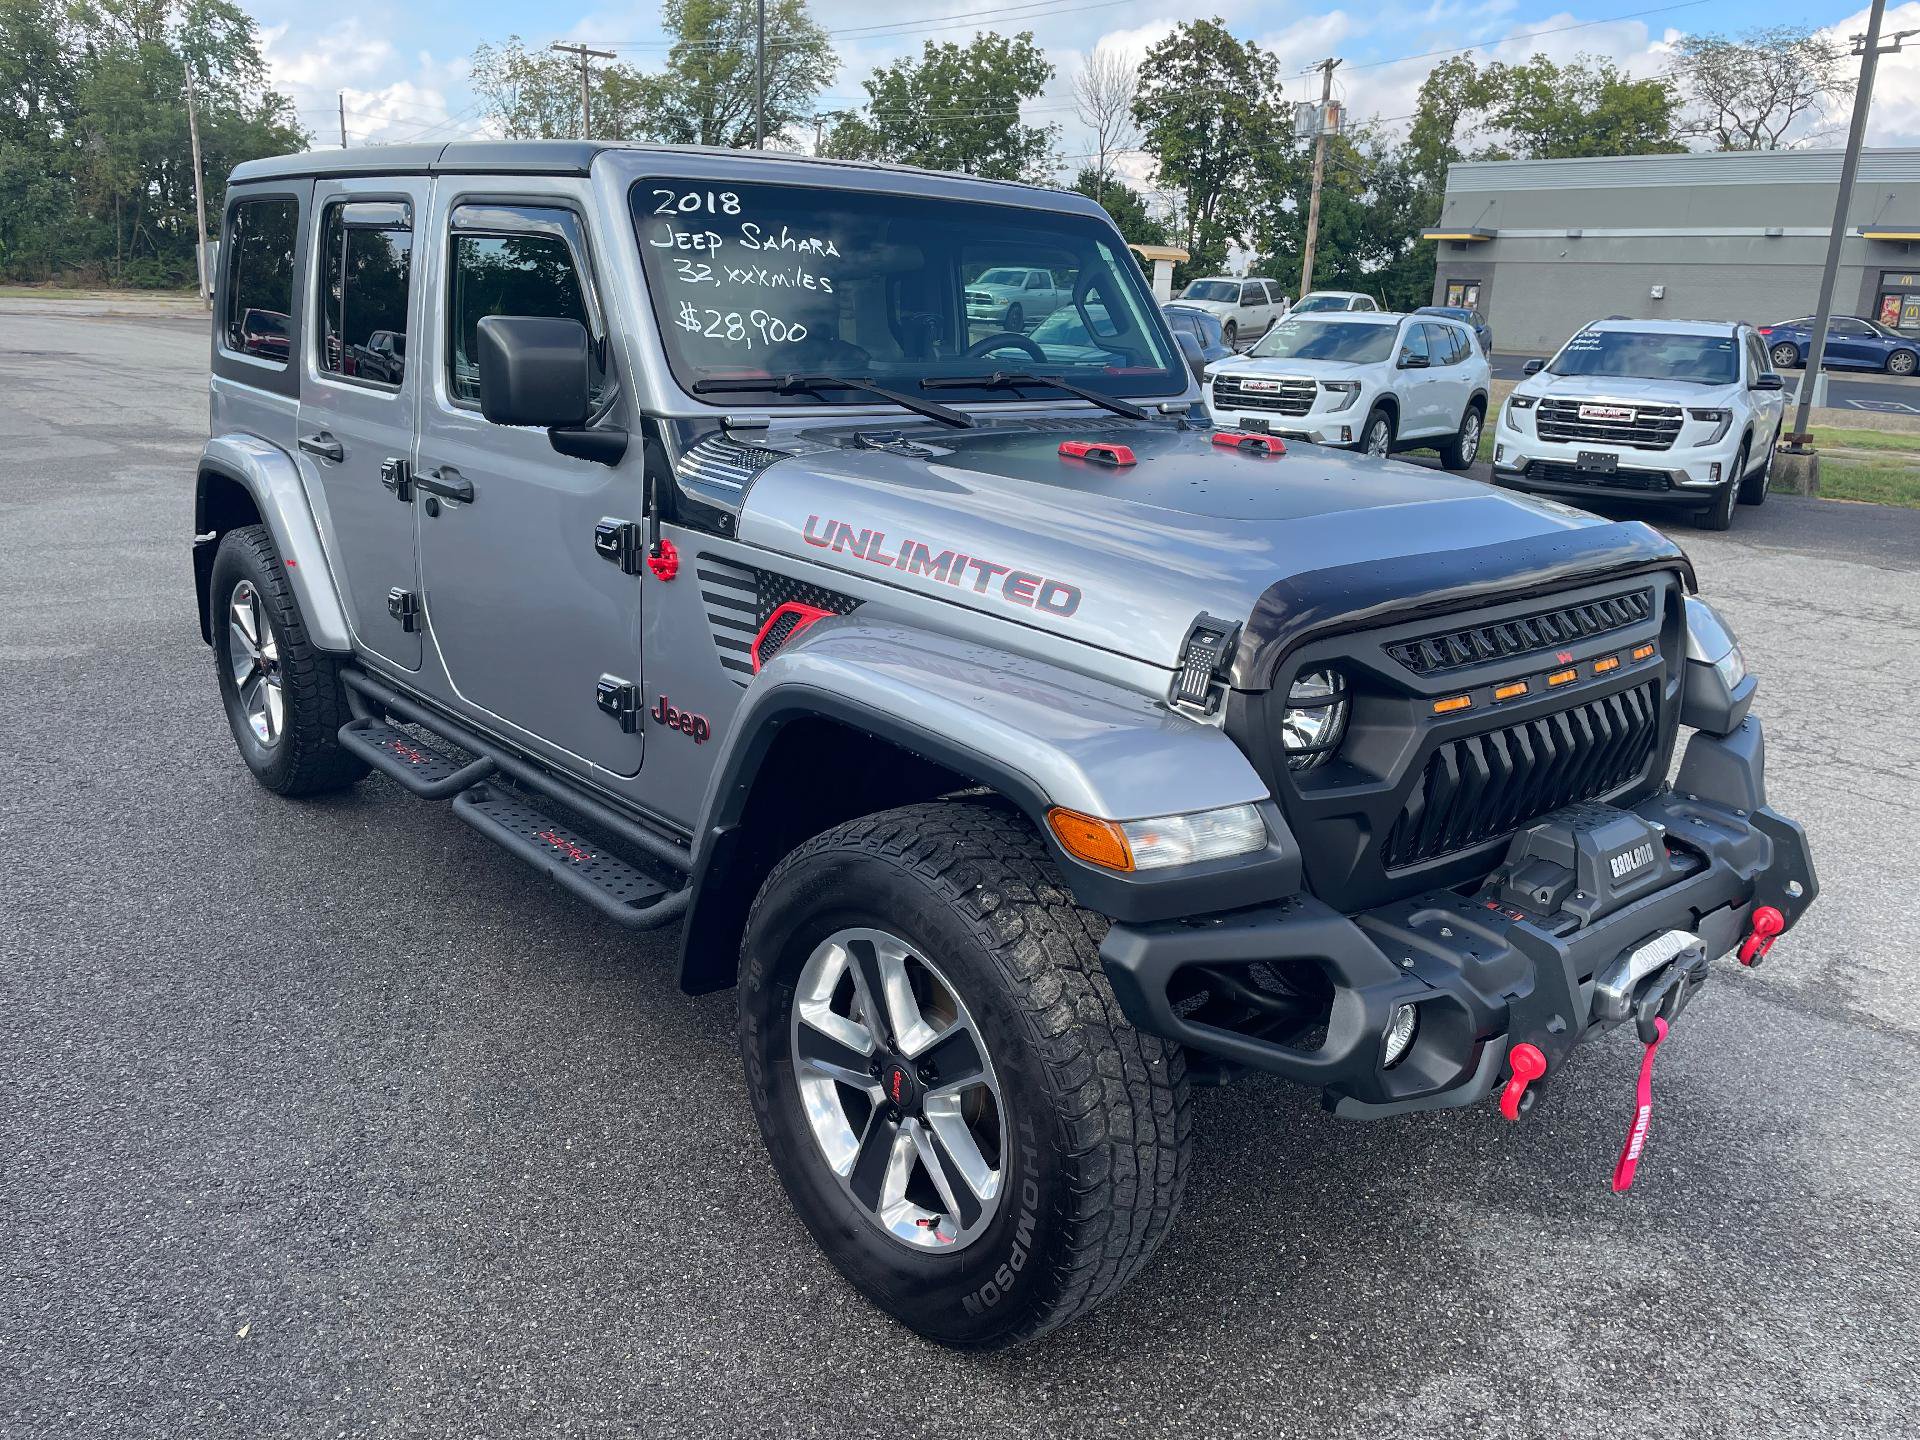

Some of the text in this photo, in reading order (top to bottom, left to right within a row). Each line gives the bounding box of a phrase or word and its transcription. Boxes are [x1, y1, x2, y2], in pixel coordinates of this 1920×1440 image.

[653, 190, 741, 215] 2018
[650, 224, 723, 259] JEEP
[675, 301, 808, 350] $28,900
[802, 514, 1083, 618] UNLIMITED
[651, 695, 710, 745] Jeep
[1610, 842, 1654, 878] BADLAND
[1627, 1105, 1651, 1160] BADLAND
[961, 1114, 1040, 1315] THOMPSON
